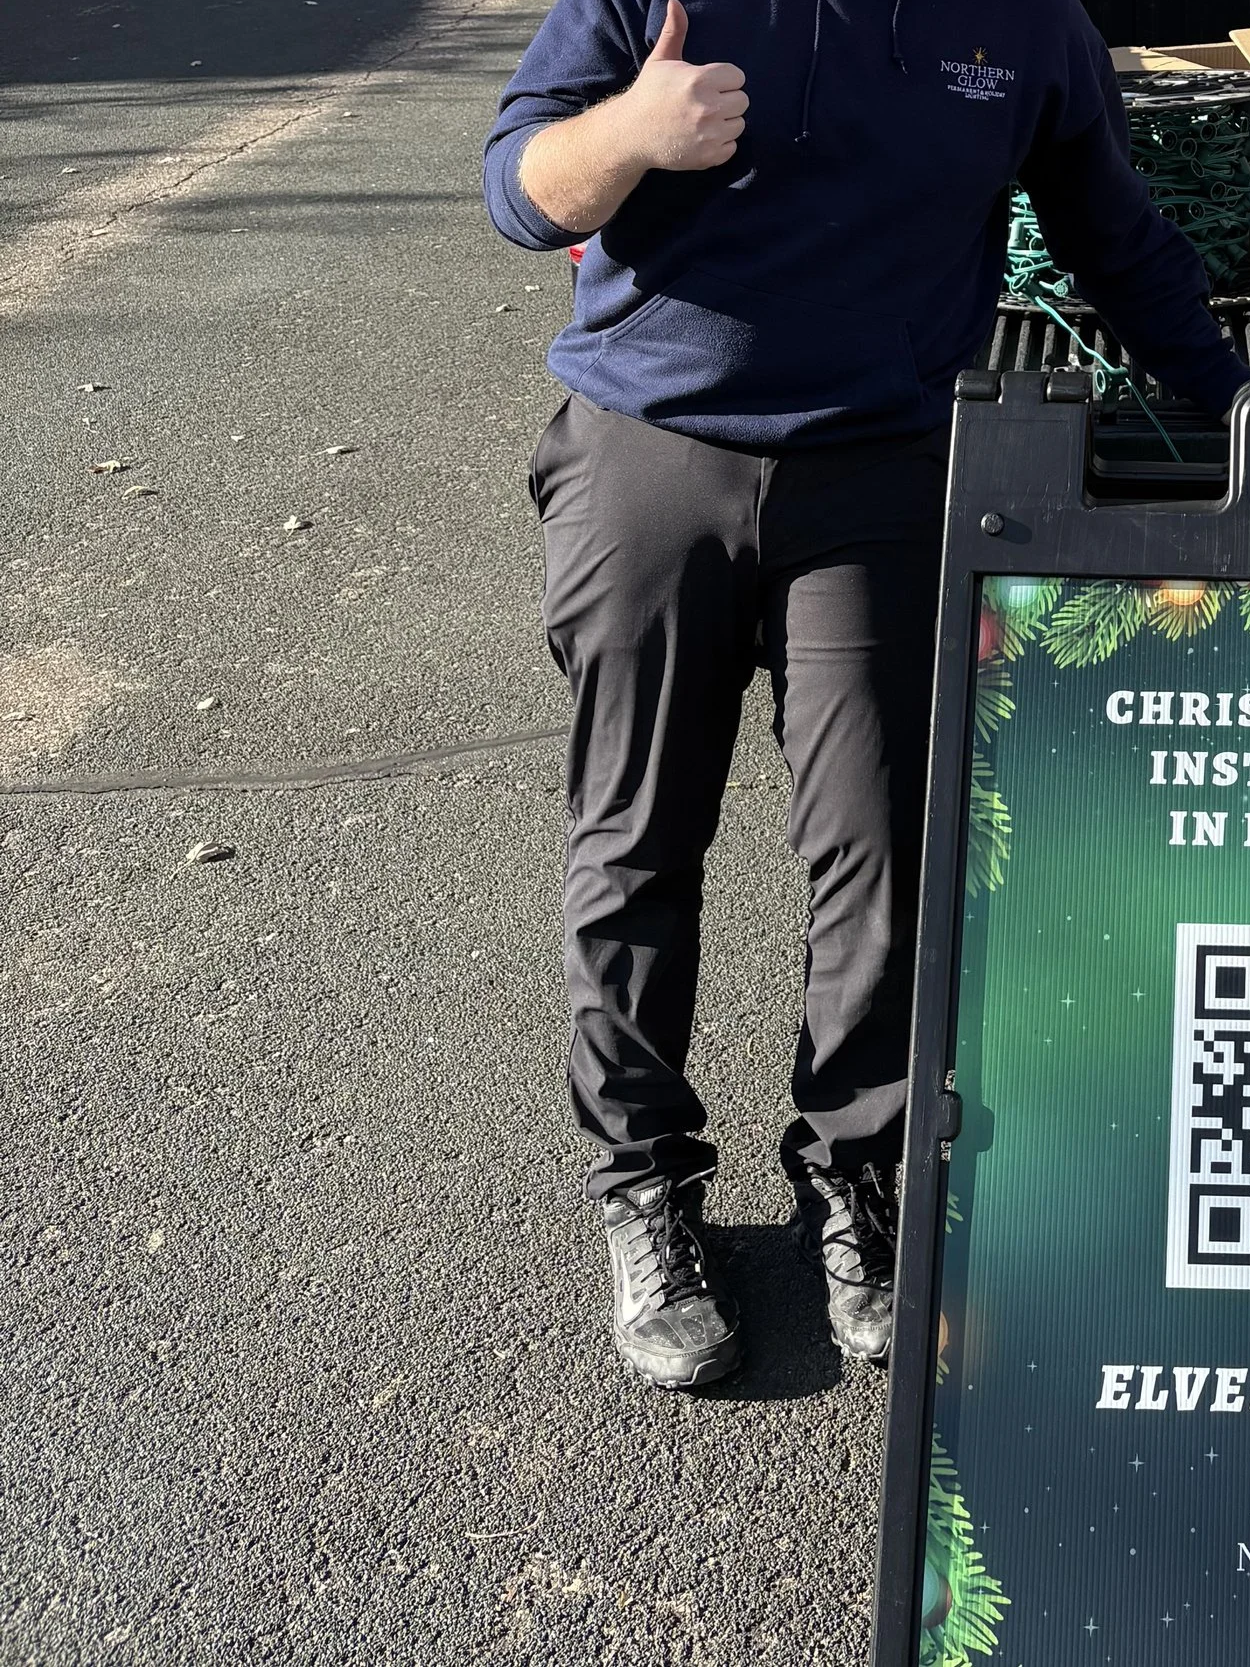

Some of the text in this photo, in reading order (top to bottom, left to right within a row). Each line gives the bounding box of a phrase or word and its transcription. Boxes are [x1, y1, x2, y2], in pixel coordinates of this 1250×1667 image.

[940, 60, 1015, 81] NORTHERN
[957, 75, 998, 90] GLOW
[1168, 810, 1228, 847] IN
[640, 1185, 664, 1206] NIKE
